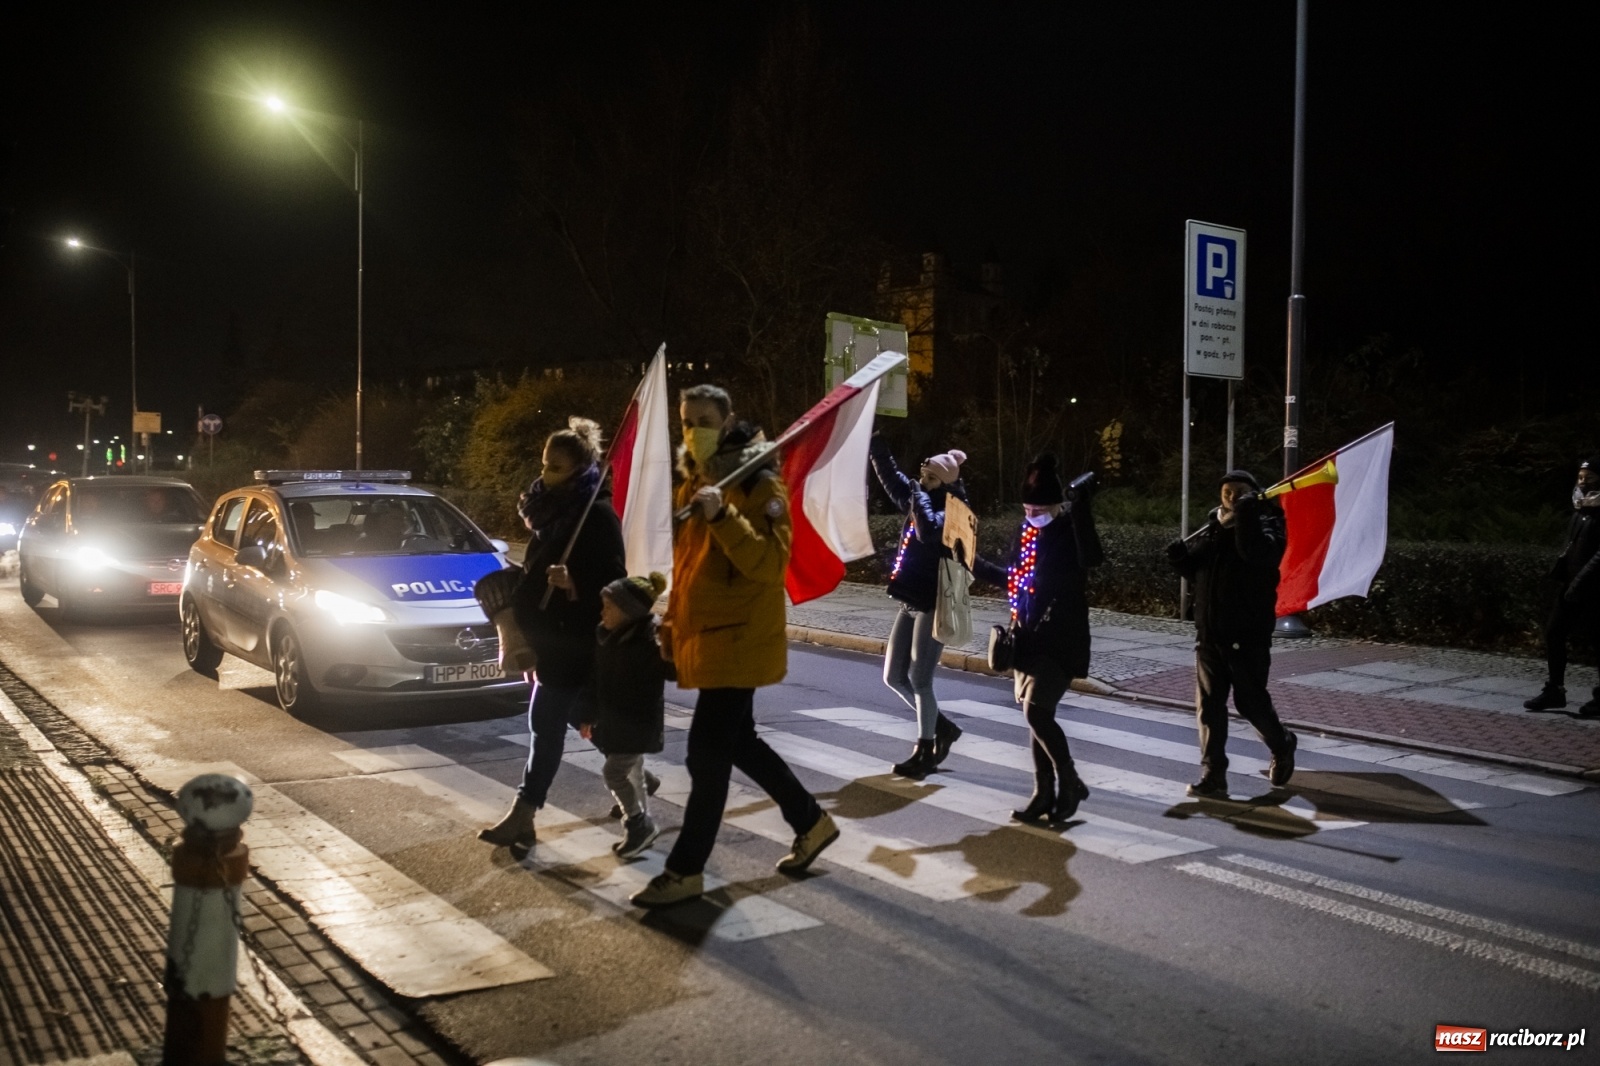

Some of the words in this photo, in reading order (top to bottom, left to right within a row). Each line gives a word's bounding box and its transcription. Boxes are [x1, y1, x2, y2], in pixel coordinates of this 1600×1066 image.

[1206, 242, 1228, 289] P
[1199, 320, 1209, 328] dni
[1211, 322, 1236, 331] robocze
[1200, 334, 1215, 343] pon.
[1203, 350, 1220, 359] godz.
[154, 584, 173, 593] SRC
[391, 579, 476, 597] POLIC
[435, 666, 466, 682] HPP
